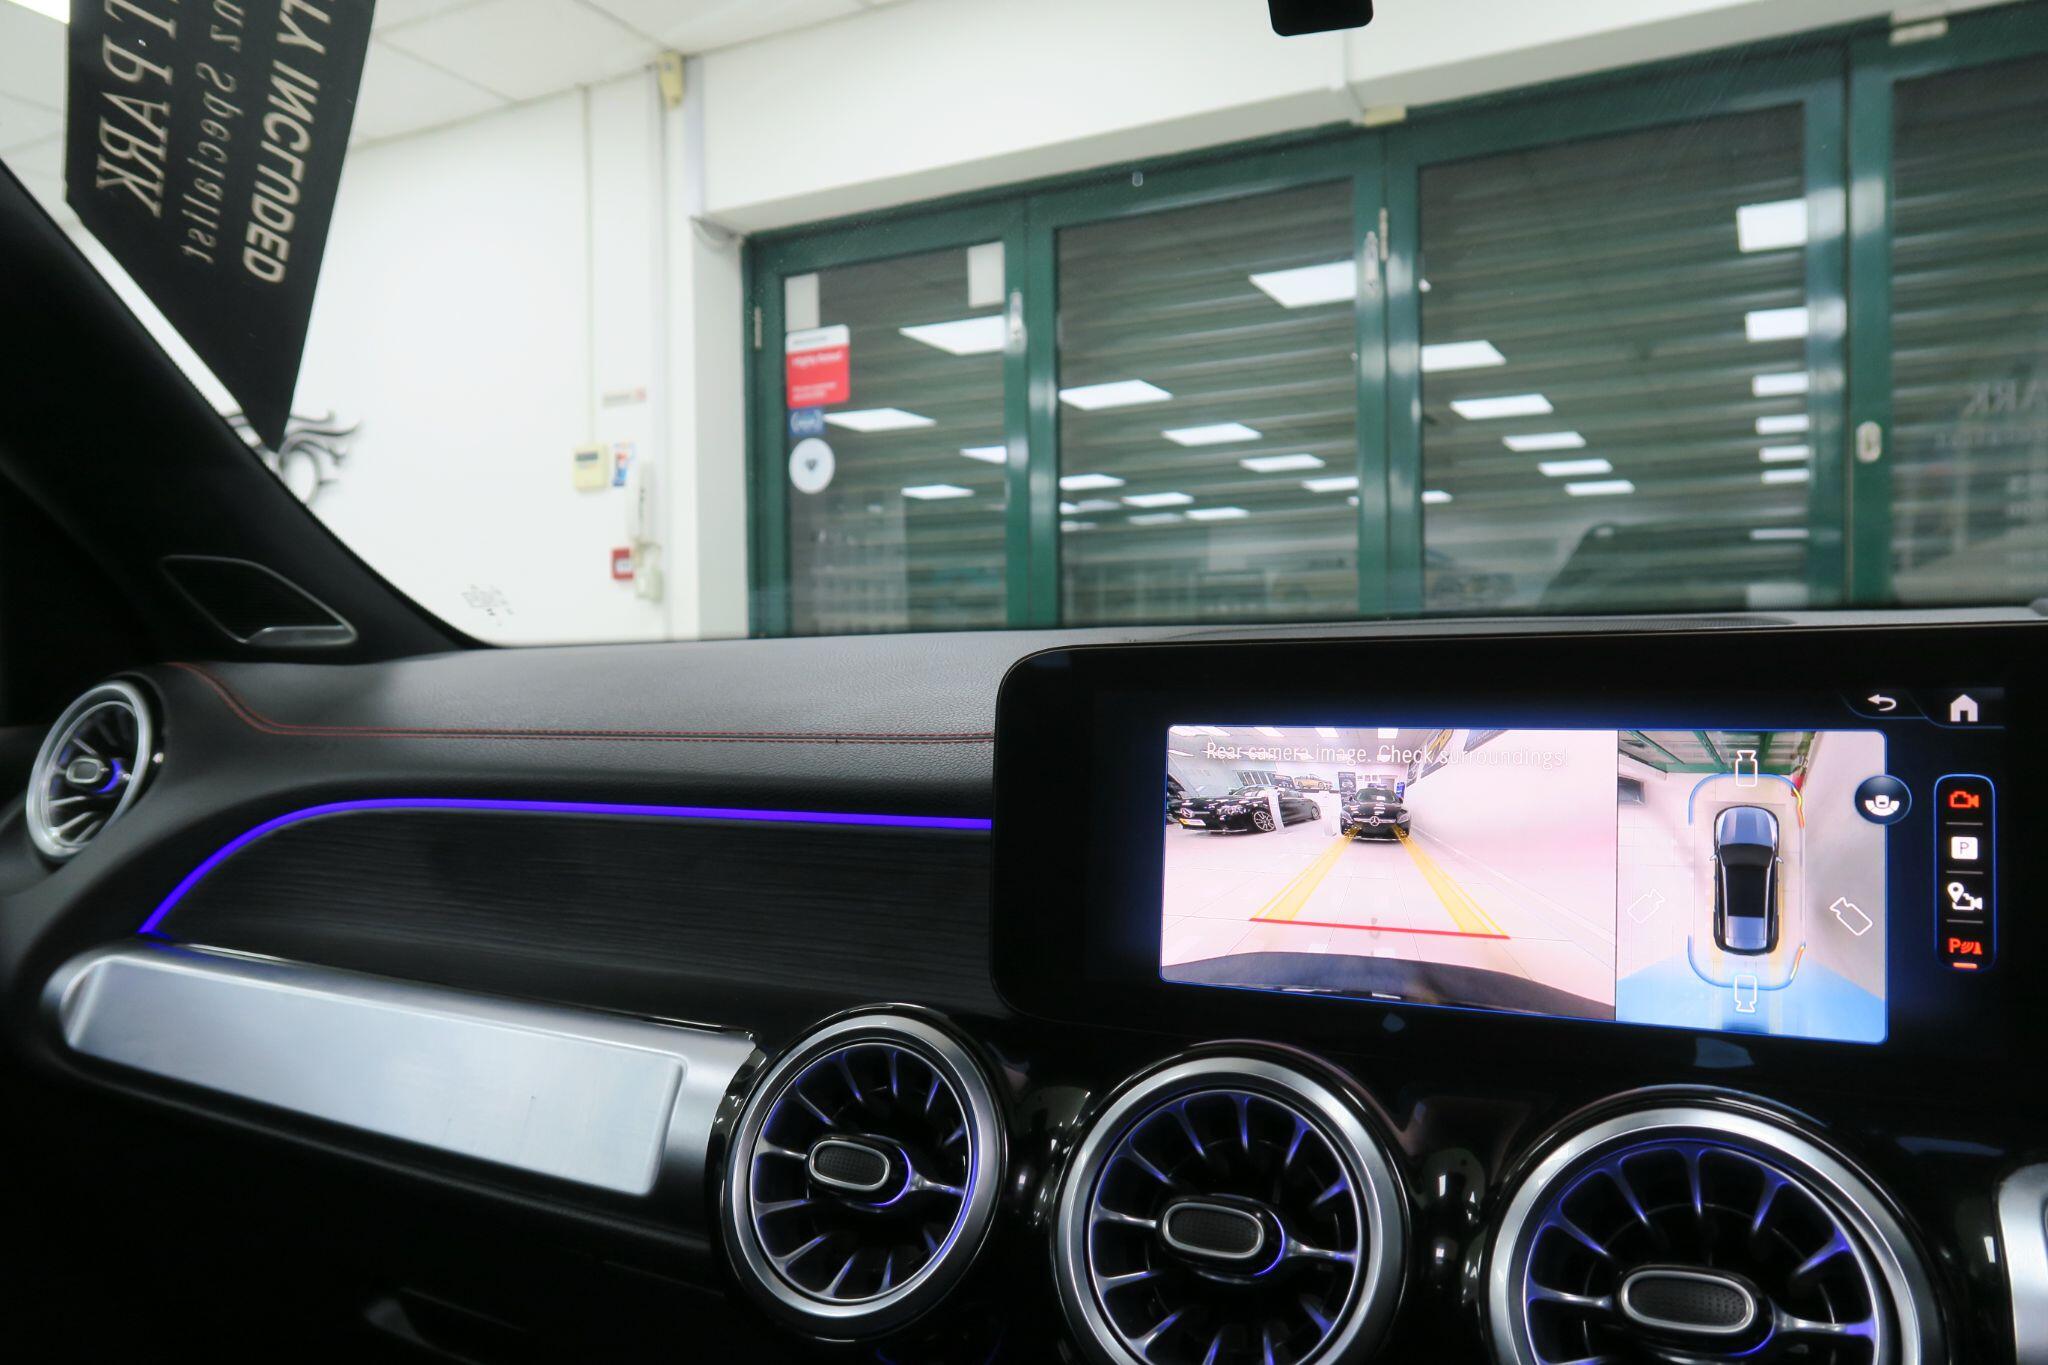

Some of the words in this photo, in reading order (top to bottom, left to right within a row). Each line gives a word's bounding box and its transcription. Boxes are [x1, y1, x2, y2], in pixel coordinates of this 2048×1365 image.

[1207, 742, 1242, 760] Rear
[1248, 746, 1309, 761] camera
[1316, 743, 1371, 766] image.
[1377, 744, 1433, 764] Check
[1440, 747, 1569, 769] surroundings!
